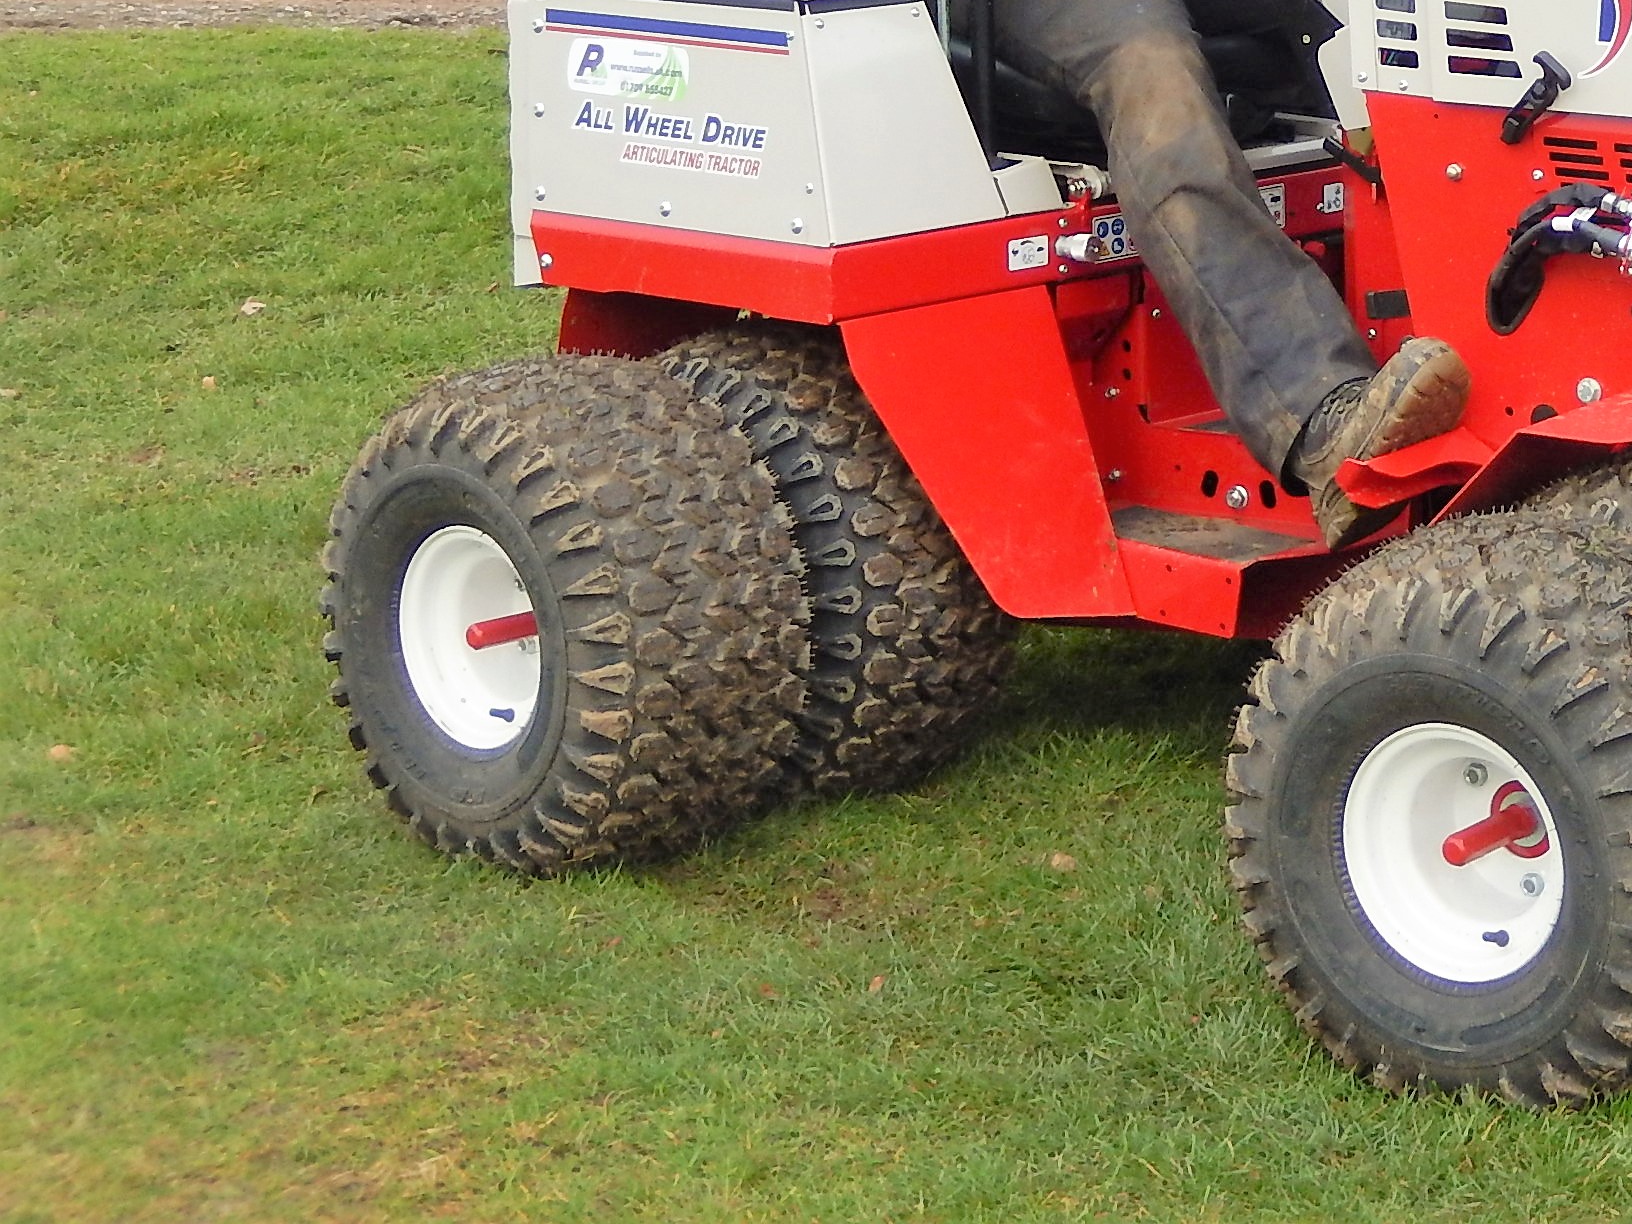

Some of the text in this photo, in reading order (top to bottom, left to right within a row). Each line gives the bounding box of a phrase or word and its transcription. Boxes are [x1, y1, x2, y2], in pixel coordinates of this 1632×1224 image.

[624, 105, 693, 140] WHEEL
[702, 116, 766, 149] DRIVE
[623, 144, 760, 176] ARTICULATING TRACTOR
